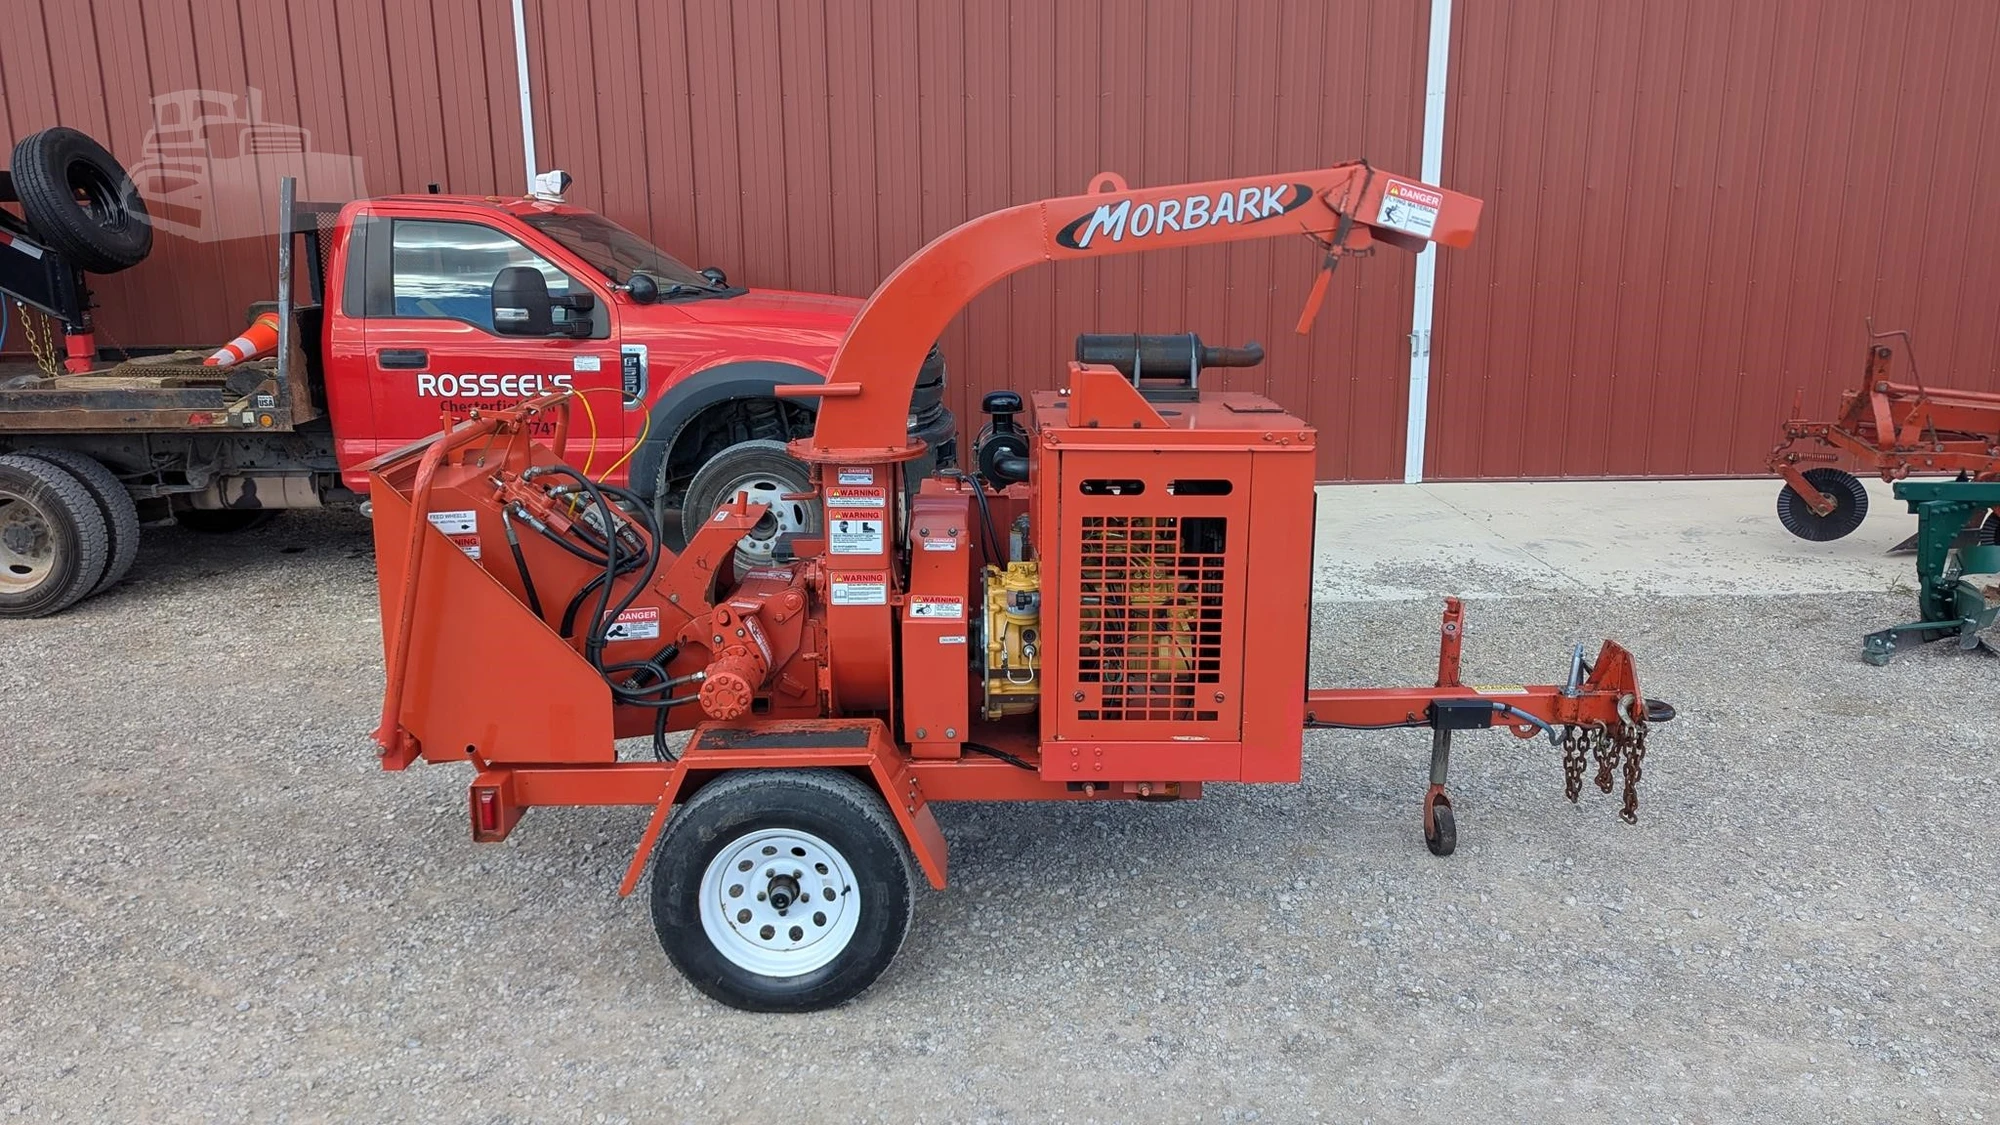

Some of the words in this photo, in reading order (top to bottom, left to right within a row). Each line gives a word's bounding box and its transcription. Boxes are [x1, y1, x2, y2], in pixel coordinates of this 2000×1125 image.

[1400, 187, 1439, 206] DANGER
[1078, 184, 1288, 248] MORBARK
[417, 374, 573, 397] ROSSEEL'S
[840, 489, 880, 497] WARNING
[842, 574, 883, 582] WARNING
